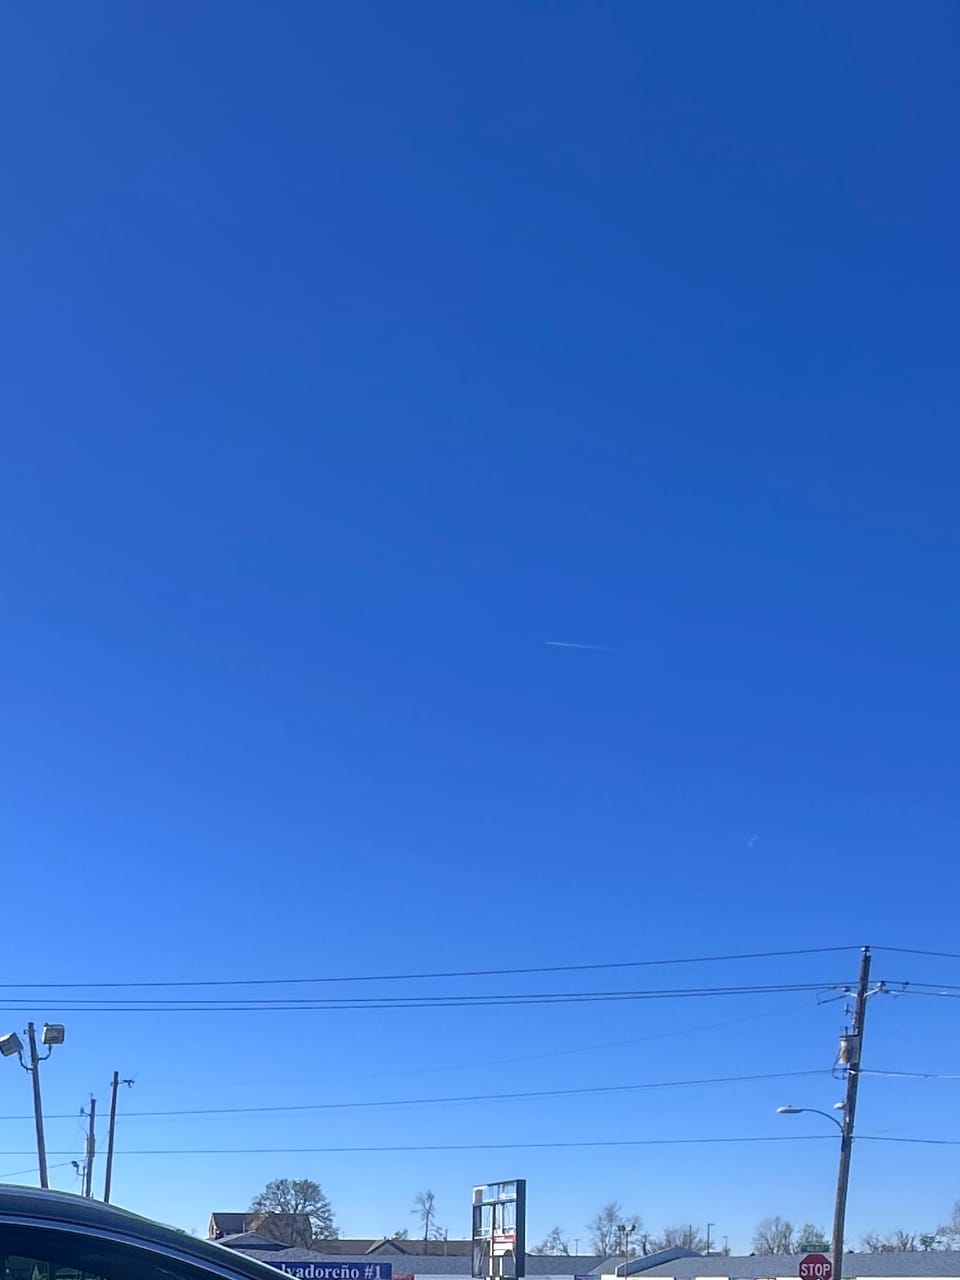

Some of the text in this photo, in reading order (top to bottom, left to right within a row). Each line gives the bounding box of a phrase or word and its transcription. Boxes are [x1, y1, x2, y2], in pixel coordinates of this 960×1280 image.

[281, 1264, 381, 1279] lvadoreño #1
[801, 1263, 830, 1276] STOP
